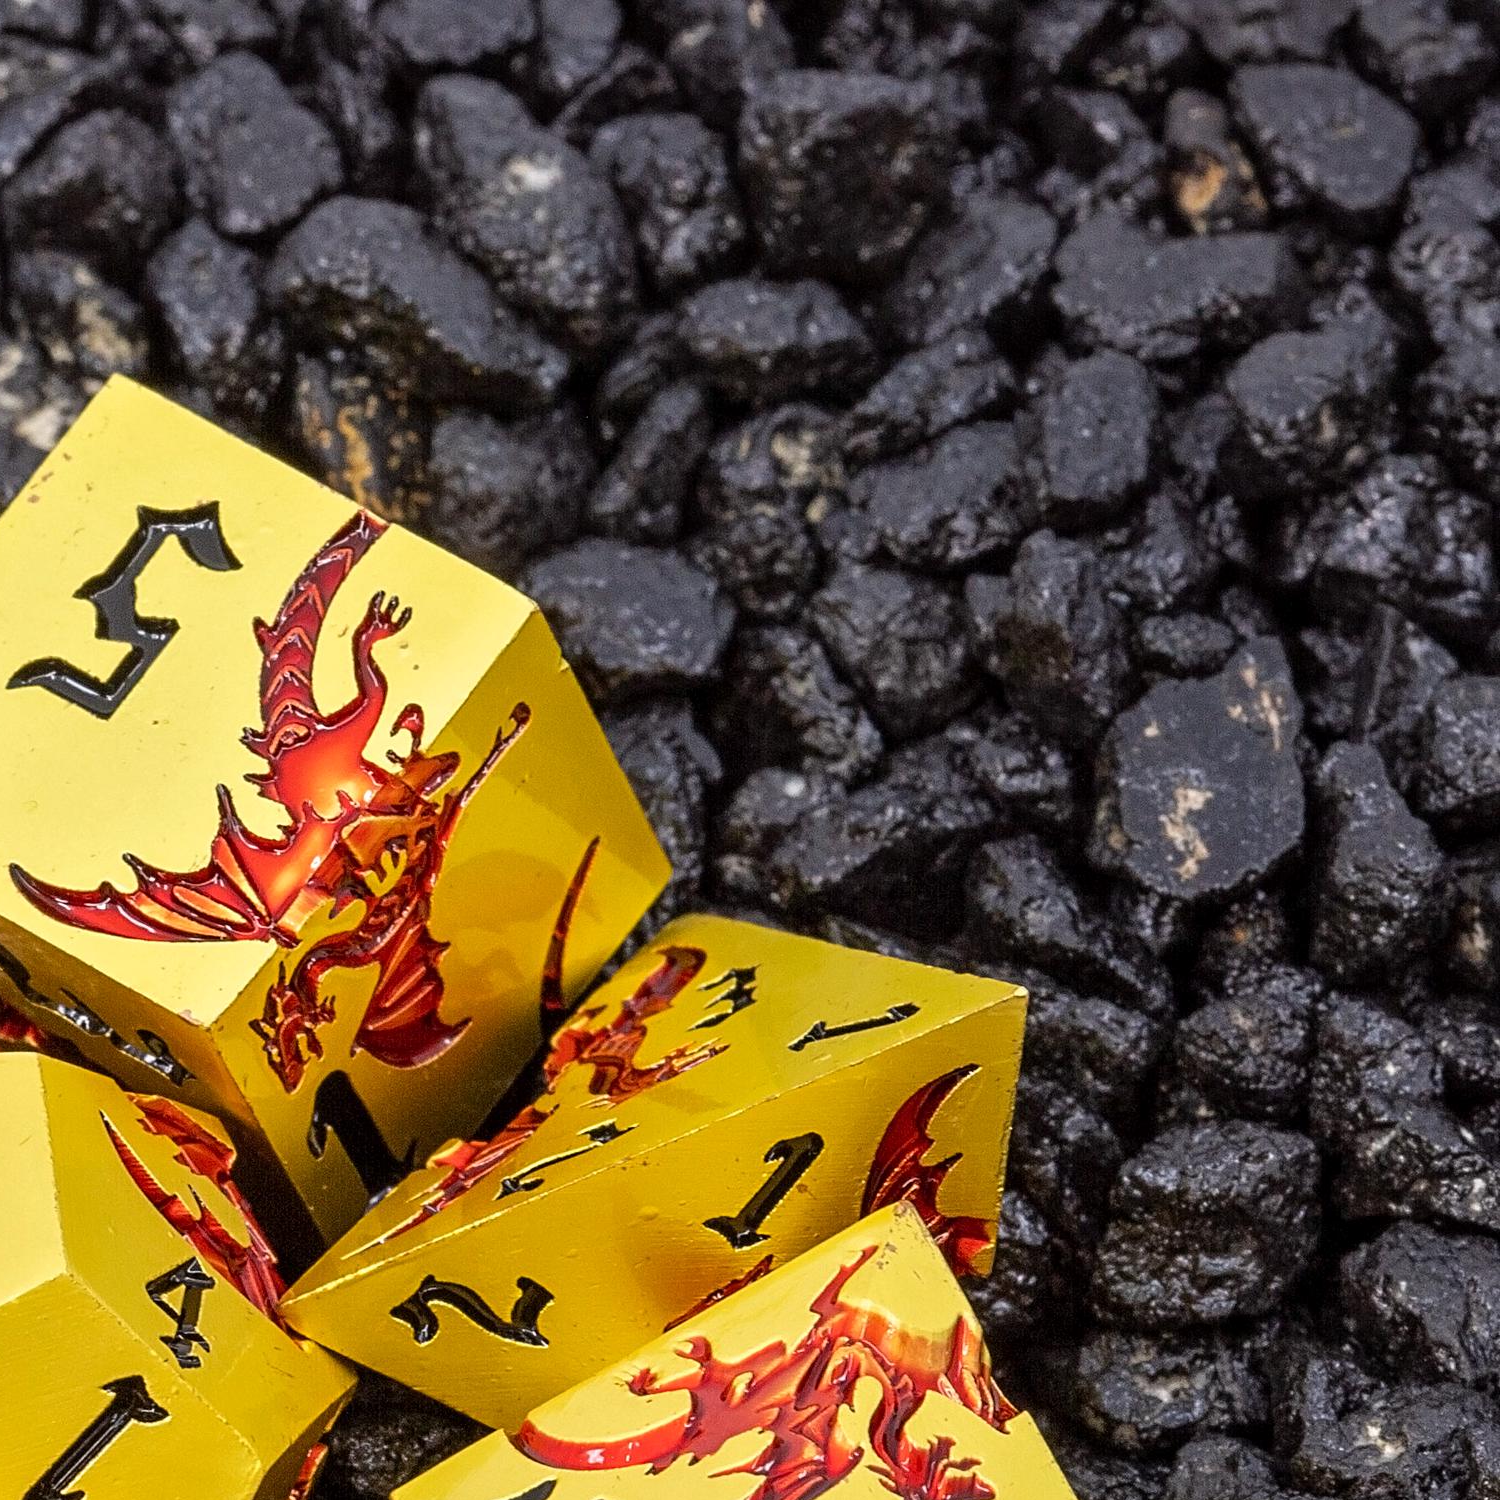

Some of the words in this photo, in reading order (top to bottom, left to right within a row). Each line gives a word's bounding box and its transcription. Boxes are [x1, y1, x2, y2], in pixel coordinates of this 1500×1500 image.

[6, 501, 243, 719] 5
[789, 1002, 920, 1051] 1
[703, 1132, 824, 1251] 1
[145, 1256, 216, 1368] 4
[390, 1275, 554, 1347] 2
